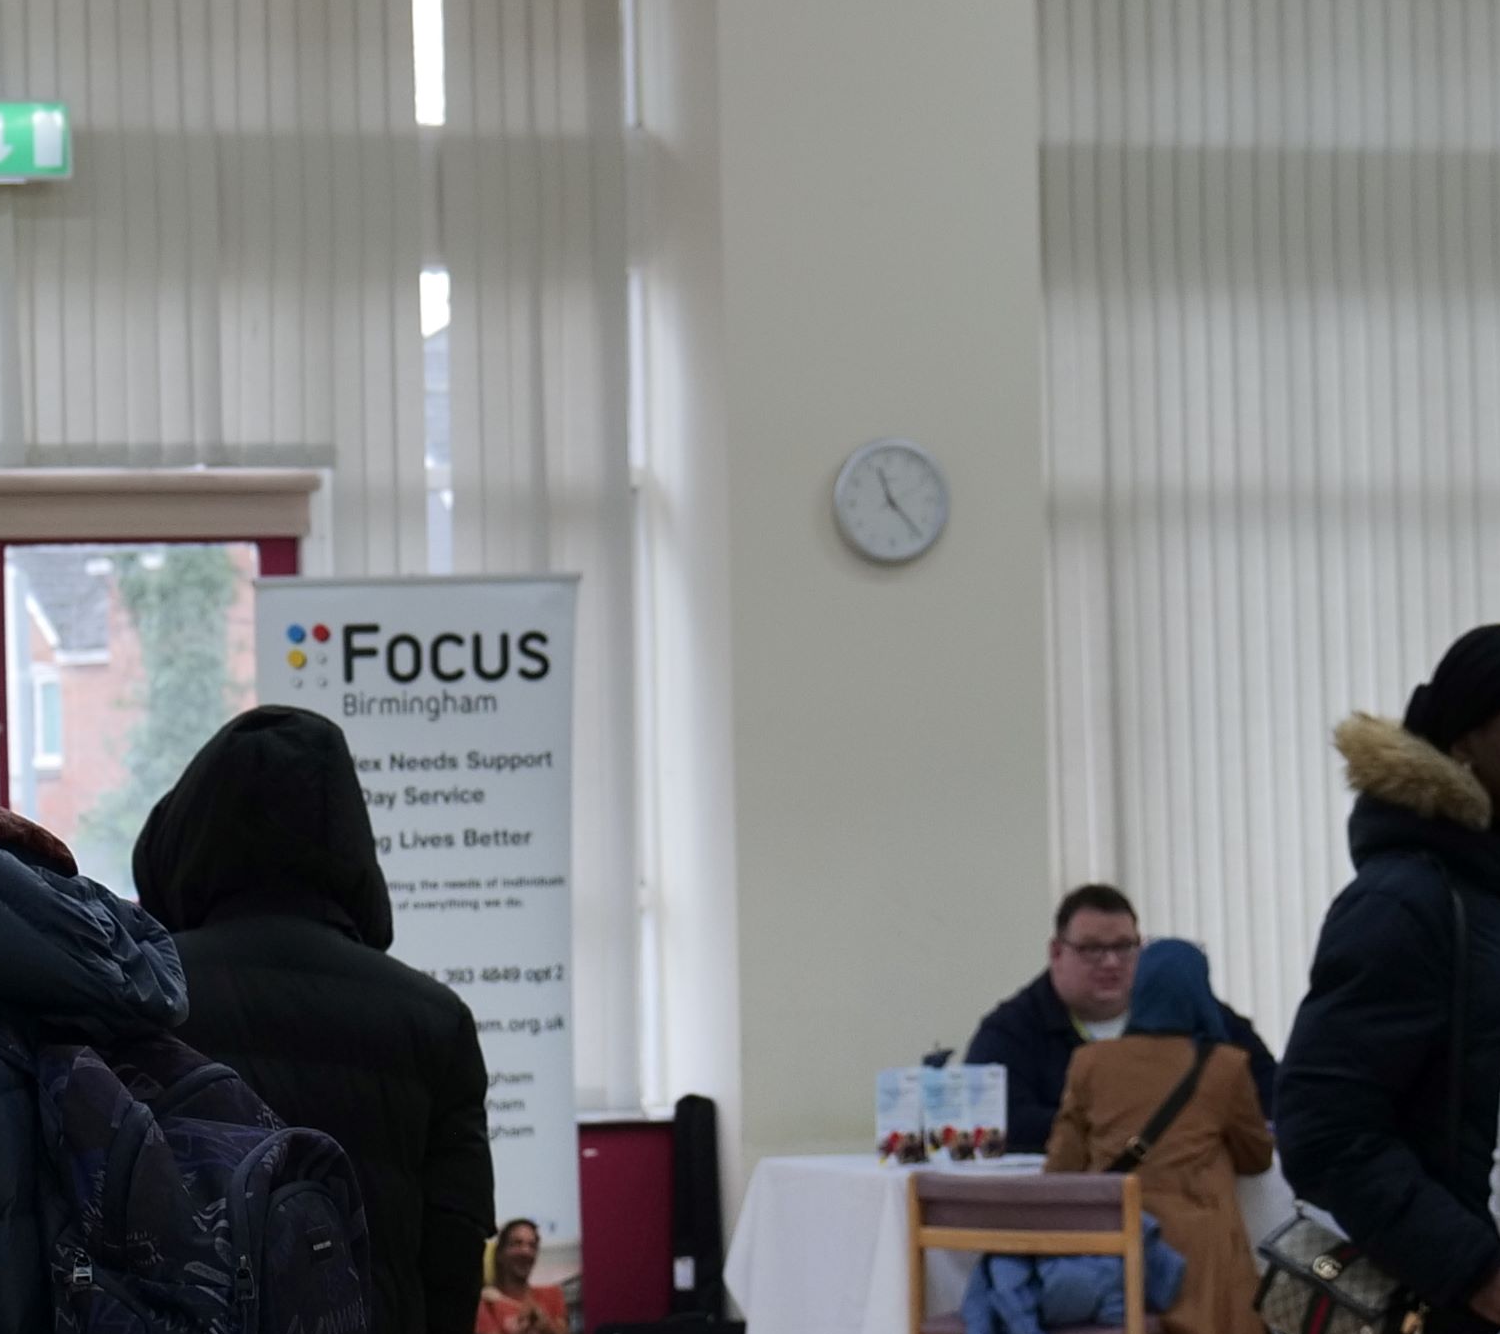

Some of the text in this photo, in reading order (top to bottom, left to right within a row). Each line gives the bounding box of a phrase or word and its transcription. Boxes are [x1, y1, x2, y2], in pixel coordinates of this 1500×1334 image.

[343, 689, 498, 722] Birmingham
[389, 751, 459, 772] Needs
[466, 750, 554, 774] Support
[403, 785, 486, 806] Service
[399, 830, 455, 850] Lives
[463, 828, 533, 848] Better
